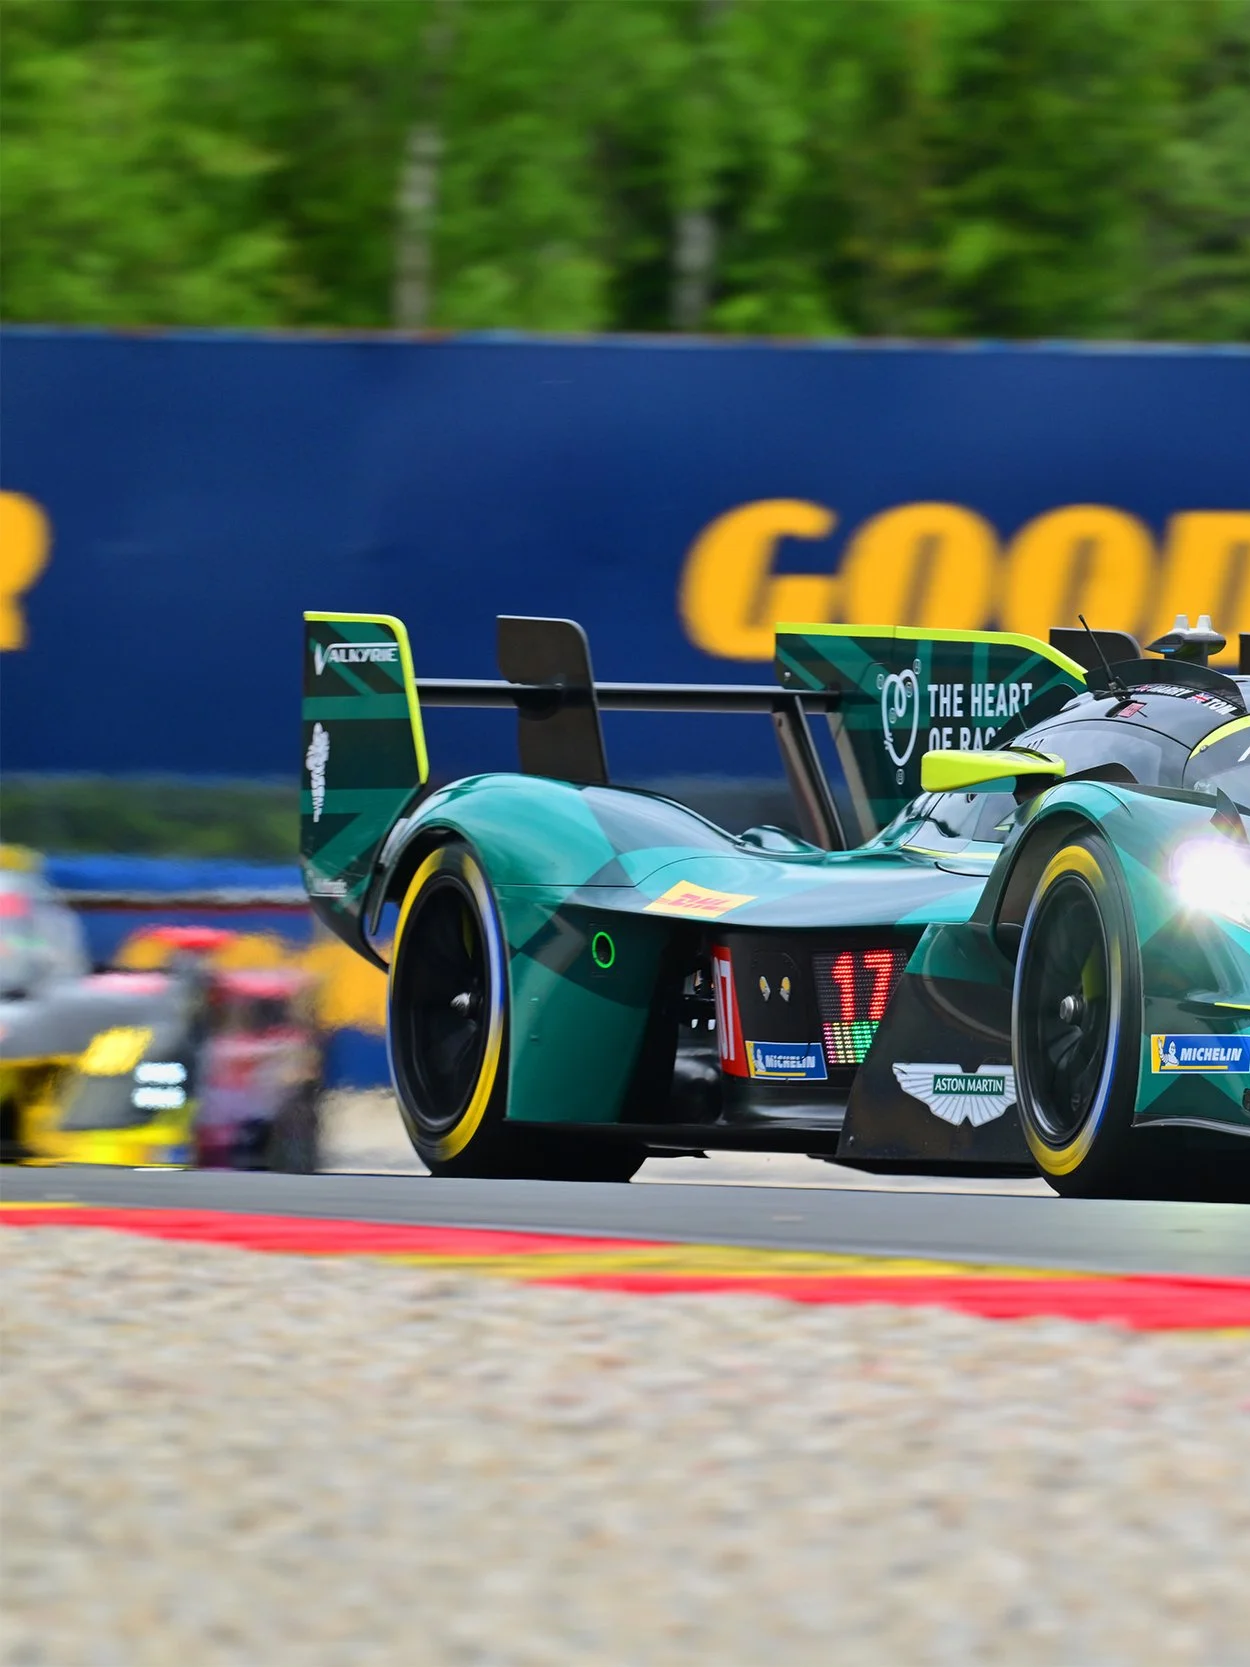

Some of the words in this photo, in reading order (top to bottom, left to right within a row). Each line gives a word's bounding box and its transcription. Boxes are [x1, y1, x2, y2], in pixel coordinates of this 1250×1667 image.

[314, 642, 398, 675] VALKYRIE
[928, 684, 963, 717] THE
[971, 682, 1032, 717] HEART
[1203, 698, 1238, 715] TOM
[668, 893, 730, 910] DHL
[832, 949, 894, 1021] 17
[765, 1054, 816, 1068] MICHELIN
[1180, 1047, 1242, 1062] MICHELIN
[935, 1077, 965, 1091] ASTON
[967, 1078, 1002, 1092] MARTIN
